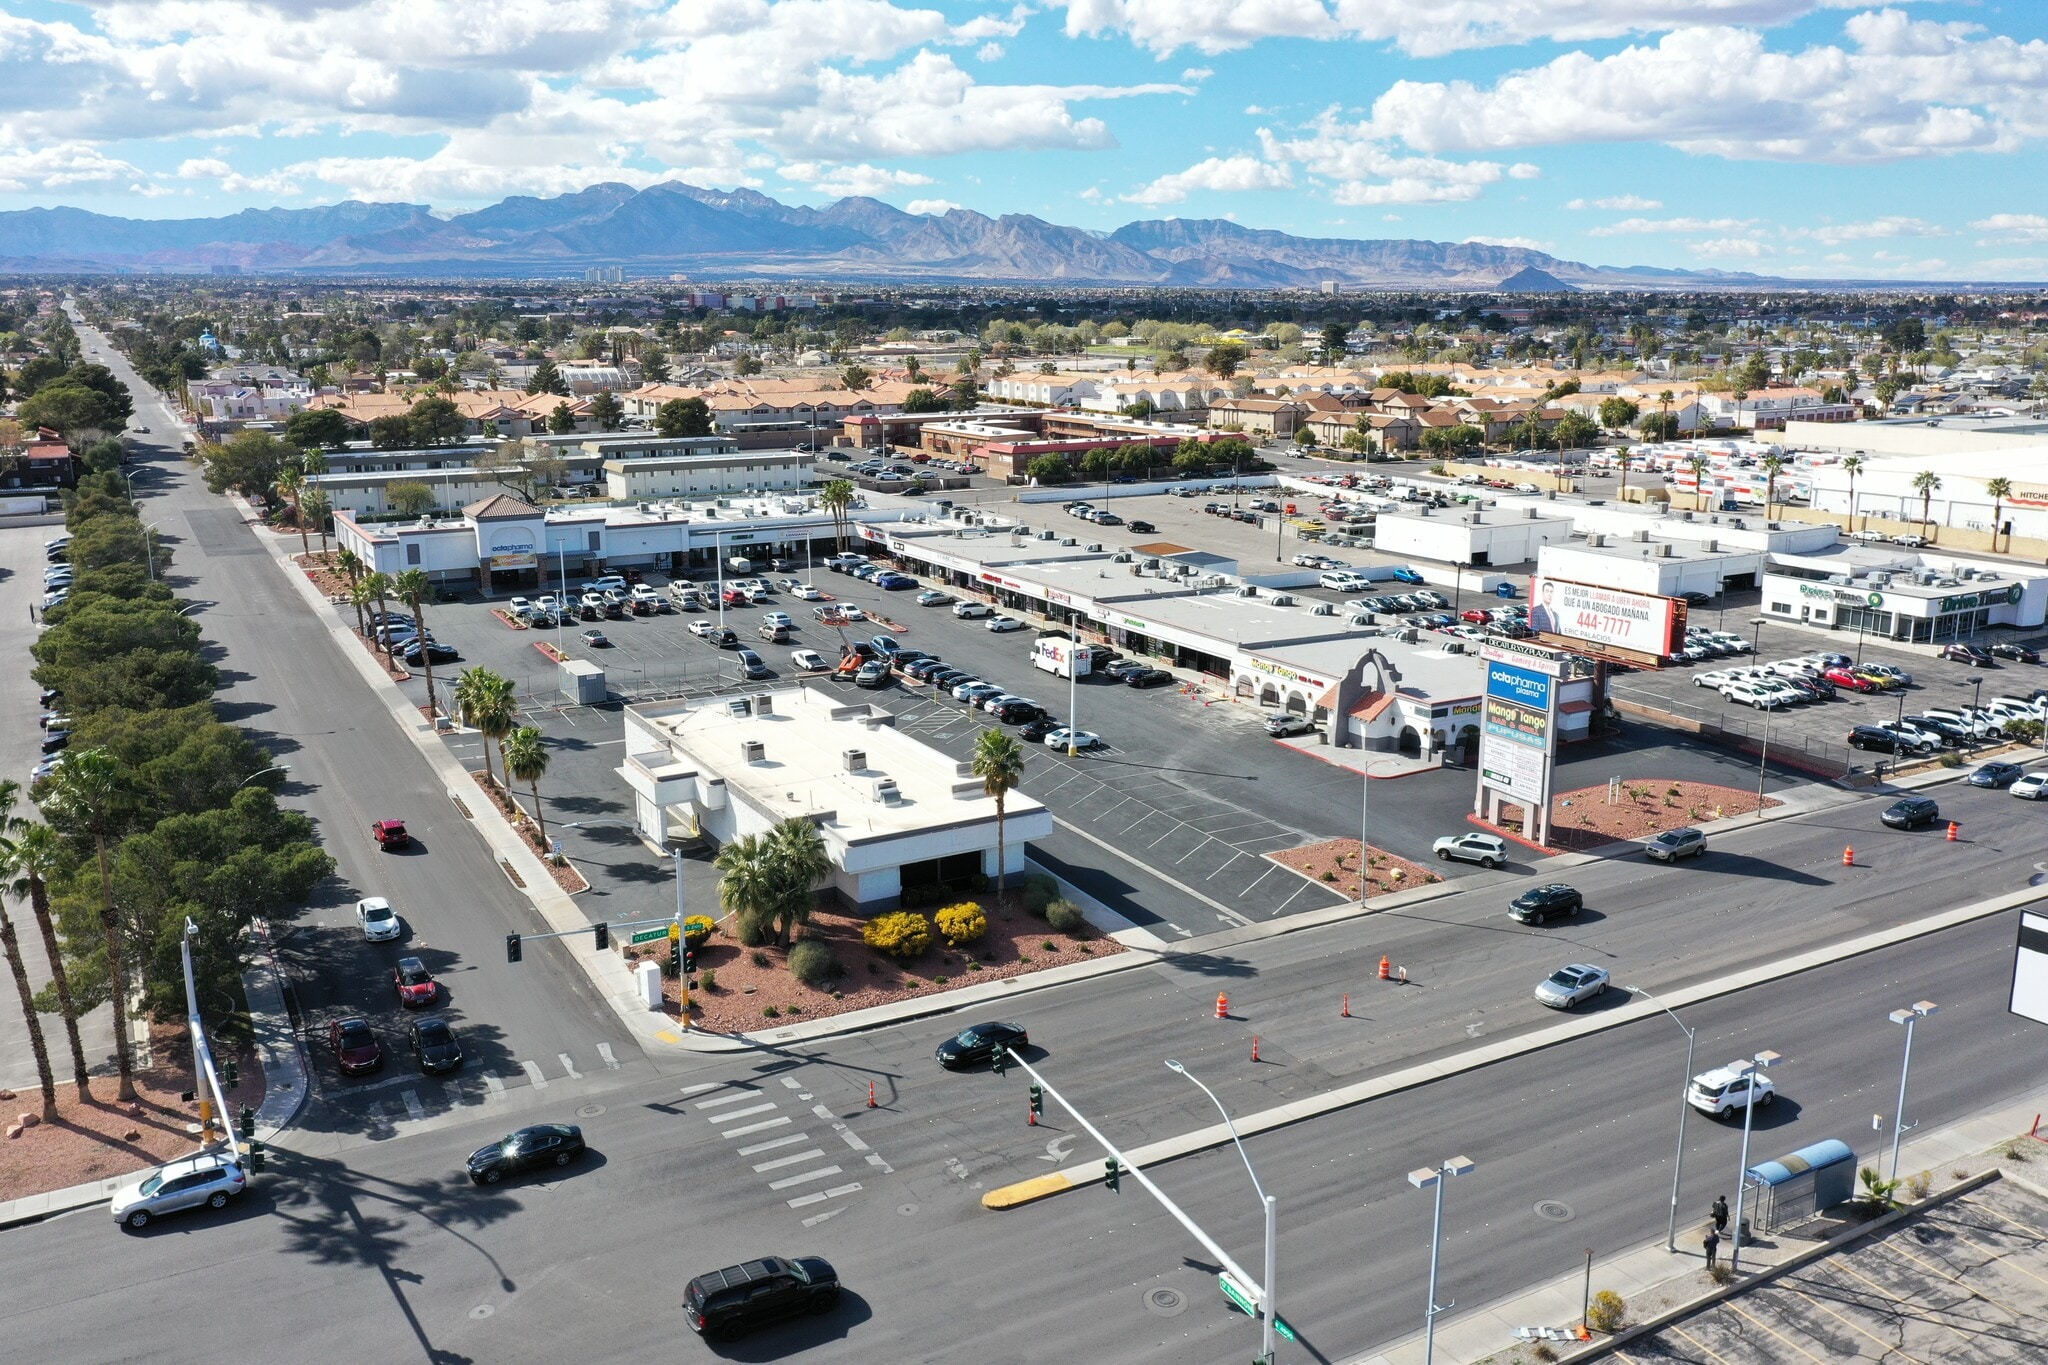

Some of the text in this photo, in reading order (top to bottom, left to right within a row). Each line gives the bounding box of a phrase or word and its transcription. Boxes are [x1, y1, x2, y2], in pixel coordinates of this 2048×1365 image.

[1564, 587, 1571, 595] ES
[1572, 588, 1589, 598] MEJOR
[1590, 590, 1610, 602] LLAMAR
[1611, 594, 1615, 602] A
[1616, 594, 1631, 605] UBER
[1564, 597, 1575, 608] QUE
[1576, 599, 1580, 607] A
[1582, 600, 1590, 610] UN
[1592, 601, 1620, 616] ABOGADO
[1577, 612, 1631, 637] 444-7777
[1564, 628, 1612, 643] ERIC PALACIOS
[1042, 643, 1064, 663] FedEx
[1512, 656, 1531, 667] Gaming
[1538, 660, 1556, 672] Spirits
[1492, 671, 1545, 692] octapharma
[1516, 687, 1539, 698] plasma
[1488, 702, 1545, 729] Mango Tango
[1488, 724, 1542, 745] PUPUSAS
[634, 931, 667, 941] DECATUR
